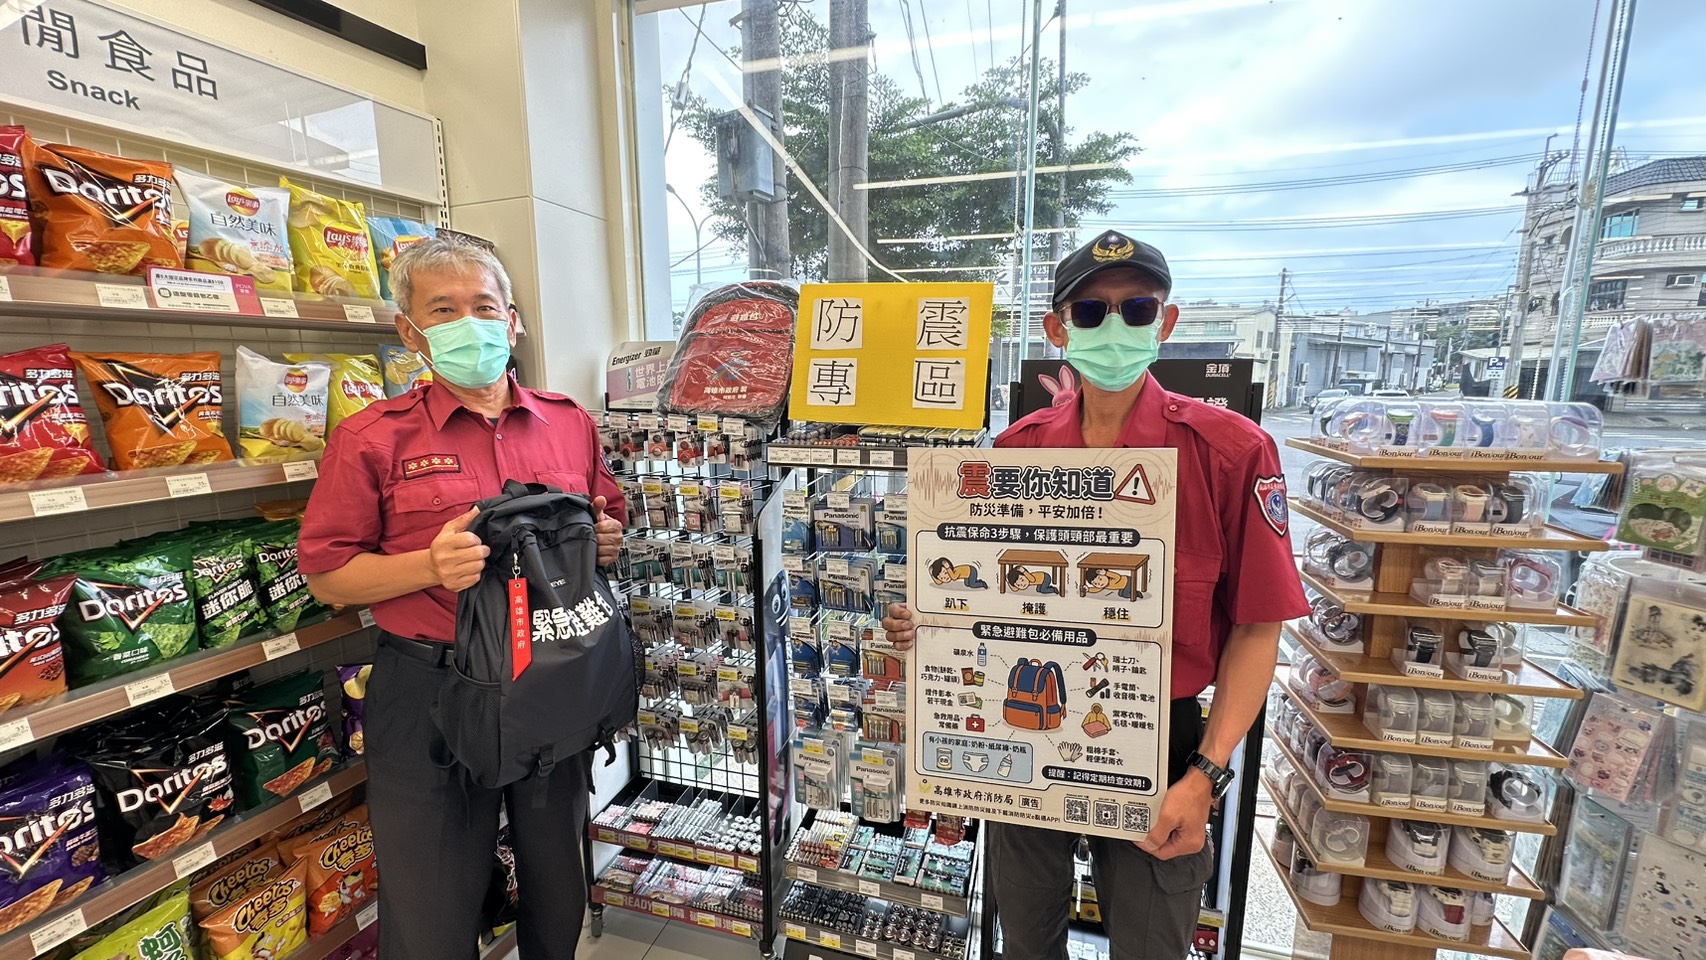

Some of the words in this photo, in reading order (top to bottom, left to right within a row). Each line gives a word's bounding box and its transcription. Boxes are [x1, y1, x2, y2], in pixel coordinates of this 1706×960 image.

[47, 69, 141, 111] Snack
[210, 213, 276, 237] 自然美味
[326, 230, 351, 247] Lay's
[612, 352, 642, 366] Energizer
[1205, 363, 1230, 374] 金頂
[26, 369, 73, 379] 多力多滋
[103, 382, 223, 406] Doritos
[272, 393, 325, 407] 自然美味
[958, 461, 1114, 499] 震要你知道
[79, 583, 188, 622] Doritos
[201, 579, 254, 620] 迷你脆
[944, 598, 969, 609] 趴下
[1022, 602, 1047, 615] 掩護
[514, 594, 527, 651] 高雄市政府
[1103, 606, 1130, 621] 穩住
[980, 624, 1089, 643] 緊急避難包必備用品
[872, 706, 906, 714] Panasonic
[187, 742, 225, 764] 多力多滋
[798, 753, 831, 765] Panasonic
[856, 765, 891, 776] Panasonic
[117, 754, 228, 813] Doritos
[933, 785, 1014, 805] 高雄市政府消防局
[1021, 797, 1039, 808] 廣告
[337, 844, 373, 869] 奇多
[208, 858, 273, 906] Cheetos
[234, 880, 297, 932] Cheetos
[250, 899, 288, 930] 奇多
